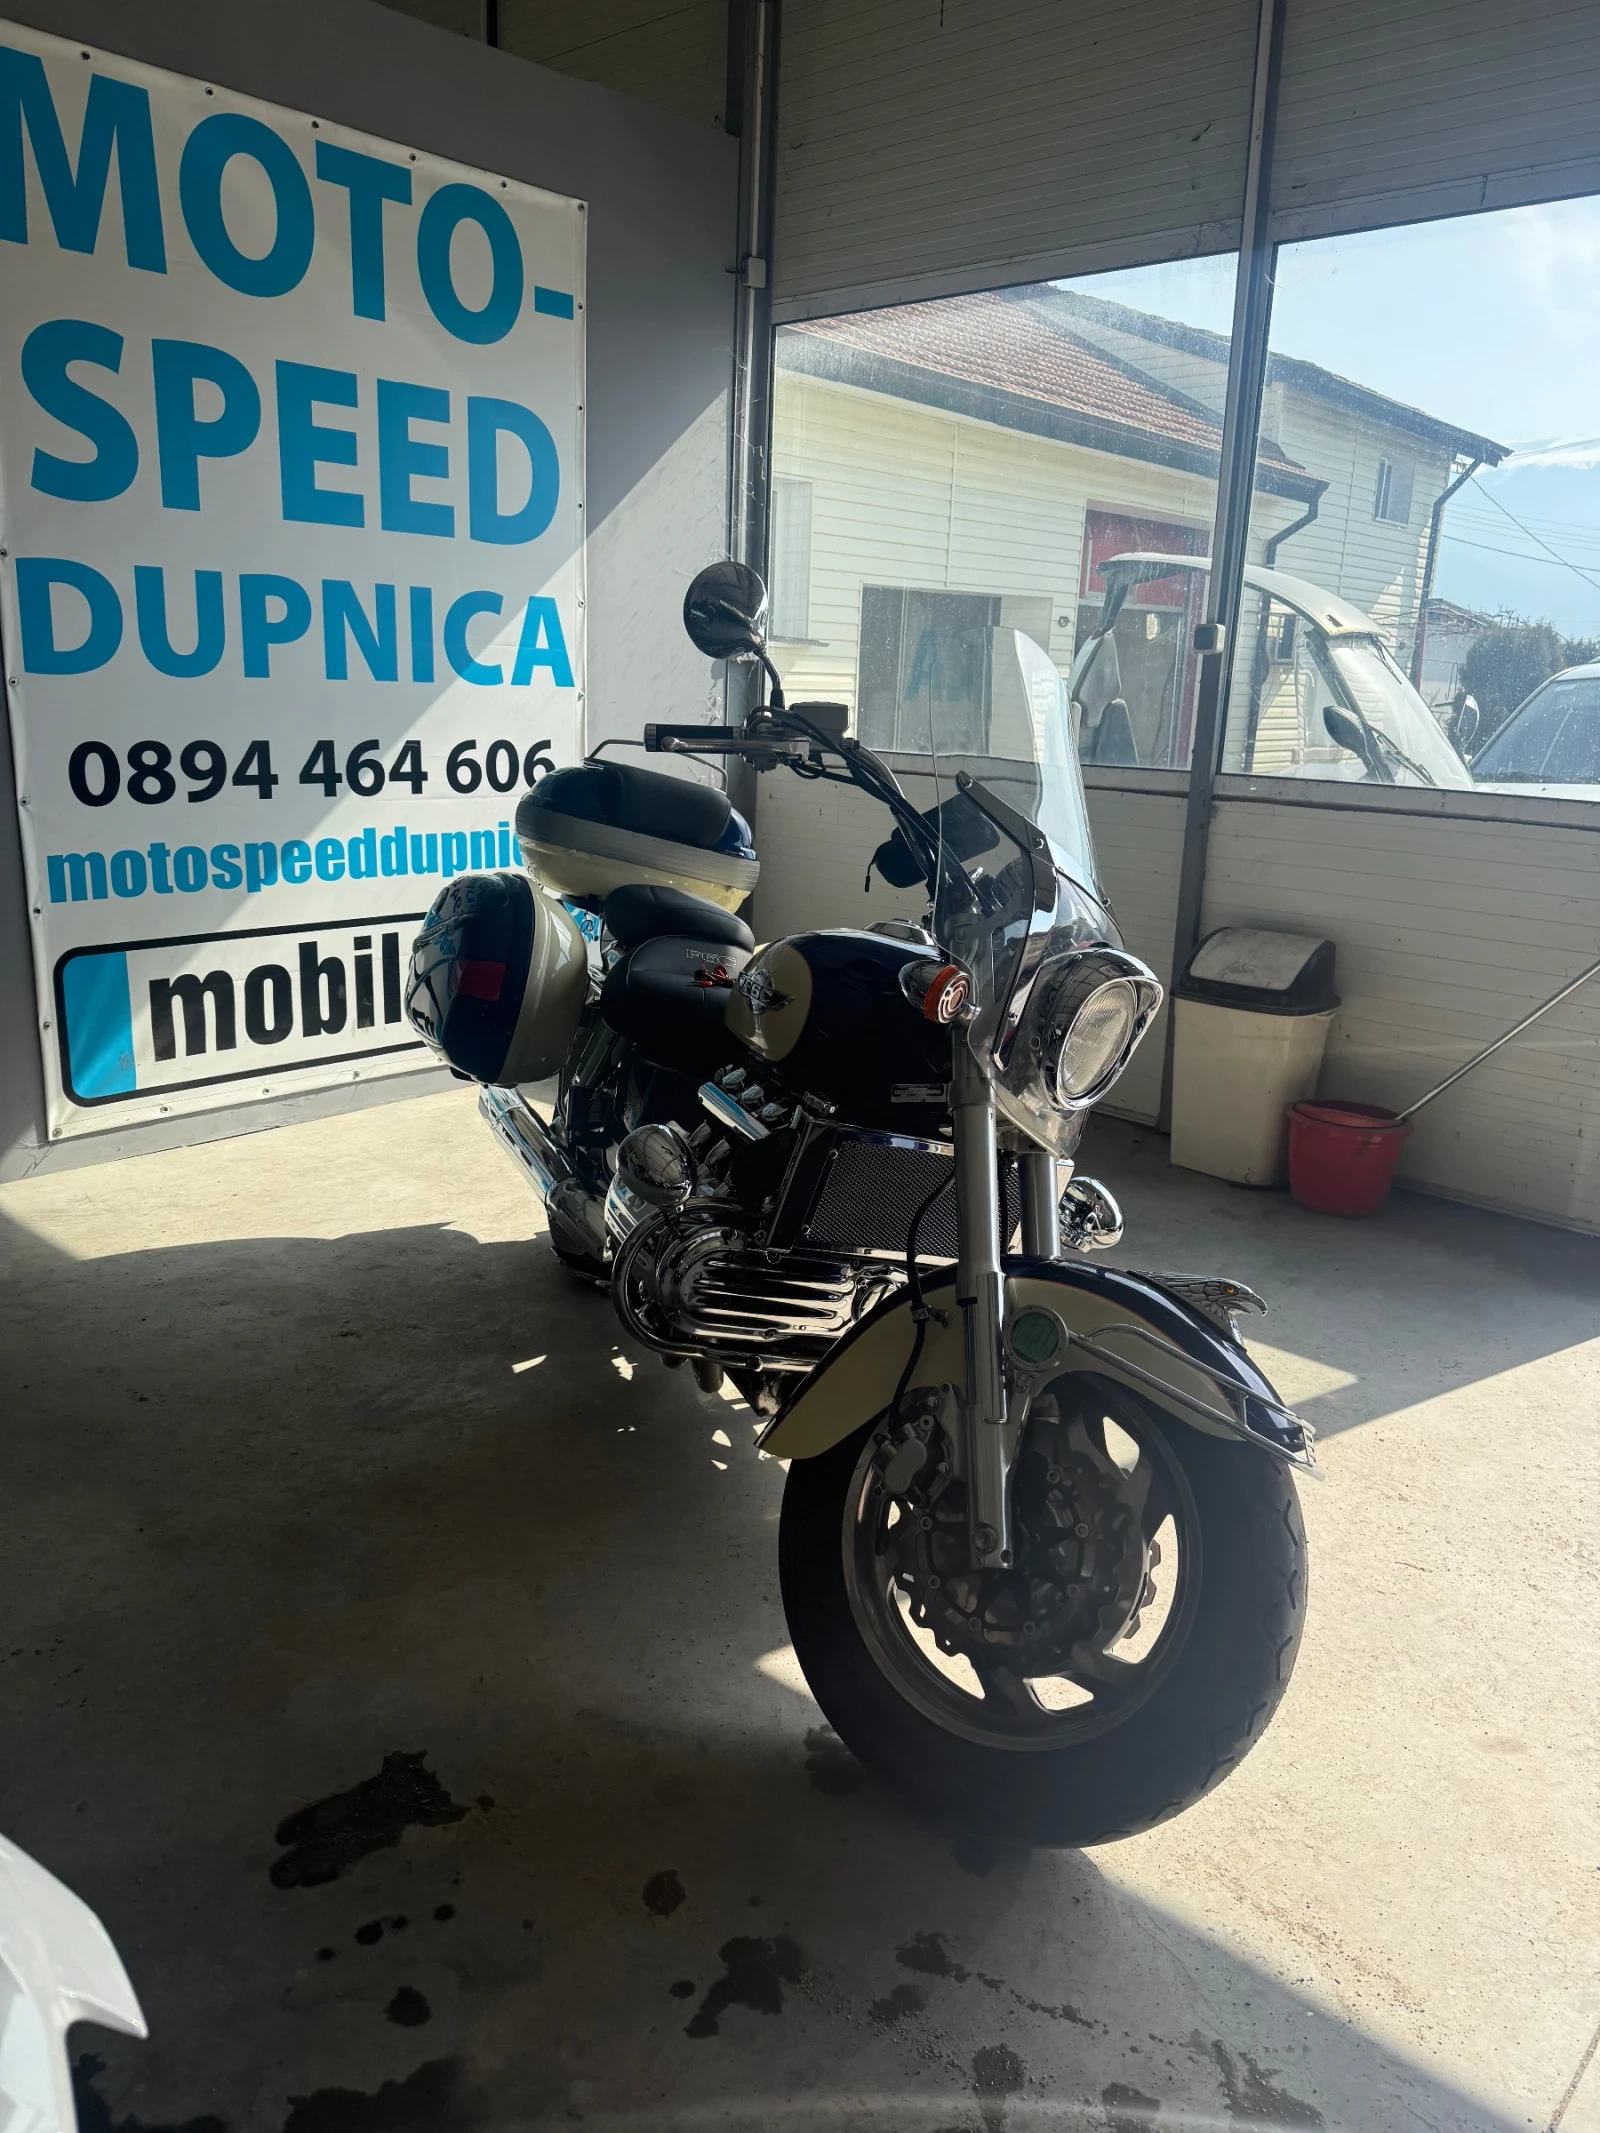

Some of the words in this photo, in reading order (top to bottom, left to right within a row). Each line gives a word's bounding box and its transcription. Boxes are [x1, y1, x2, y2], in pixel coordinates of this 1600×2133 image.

[0, 46, 574, 345] MOTO-
[21, 319, 561, 547] SPEED
[15, 557, 576, 689] DUPNICA
[68, 740, 279, 808] 0894
[299, 739, 428, 797] 464
[446, 739, 556, 793] 606
